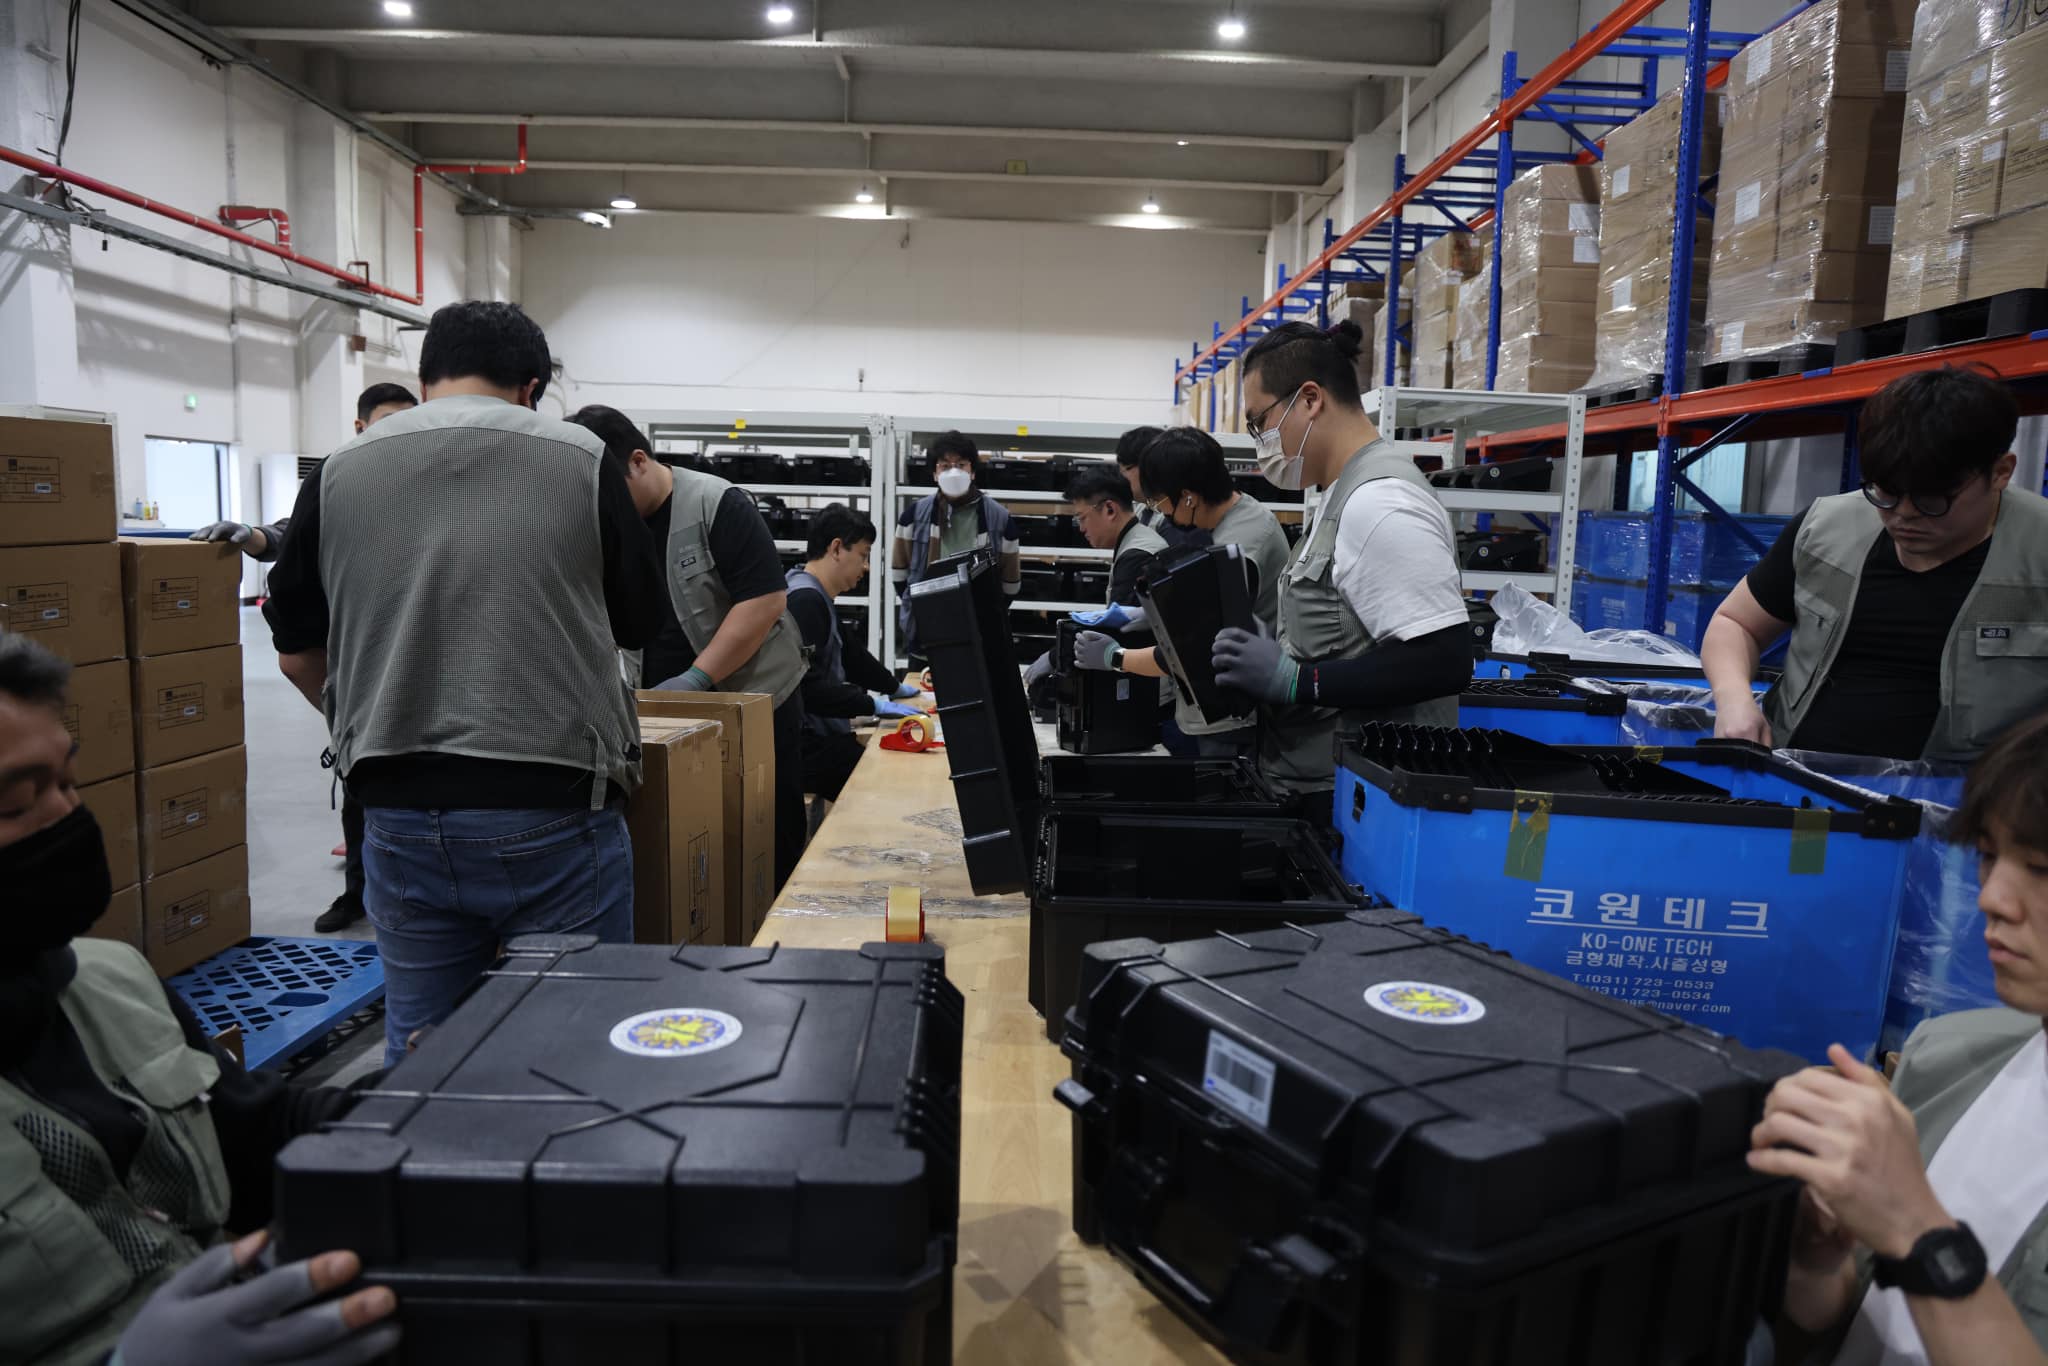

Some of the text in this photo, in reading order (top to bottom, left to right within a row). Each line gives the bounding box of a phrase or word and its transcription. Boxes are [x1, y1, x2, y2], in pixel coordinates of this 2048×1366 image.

[1530, 888, 1769, 932] 코원테크
[1580, 932, 1713, 956] KO-ONE TECH
[1633, 977, 1715, 990] 723-0533
[1631, 988, 1711, 1000] 723-0534
